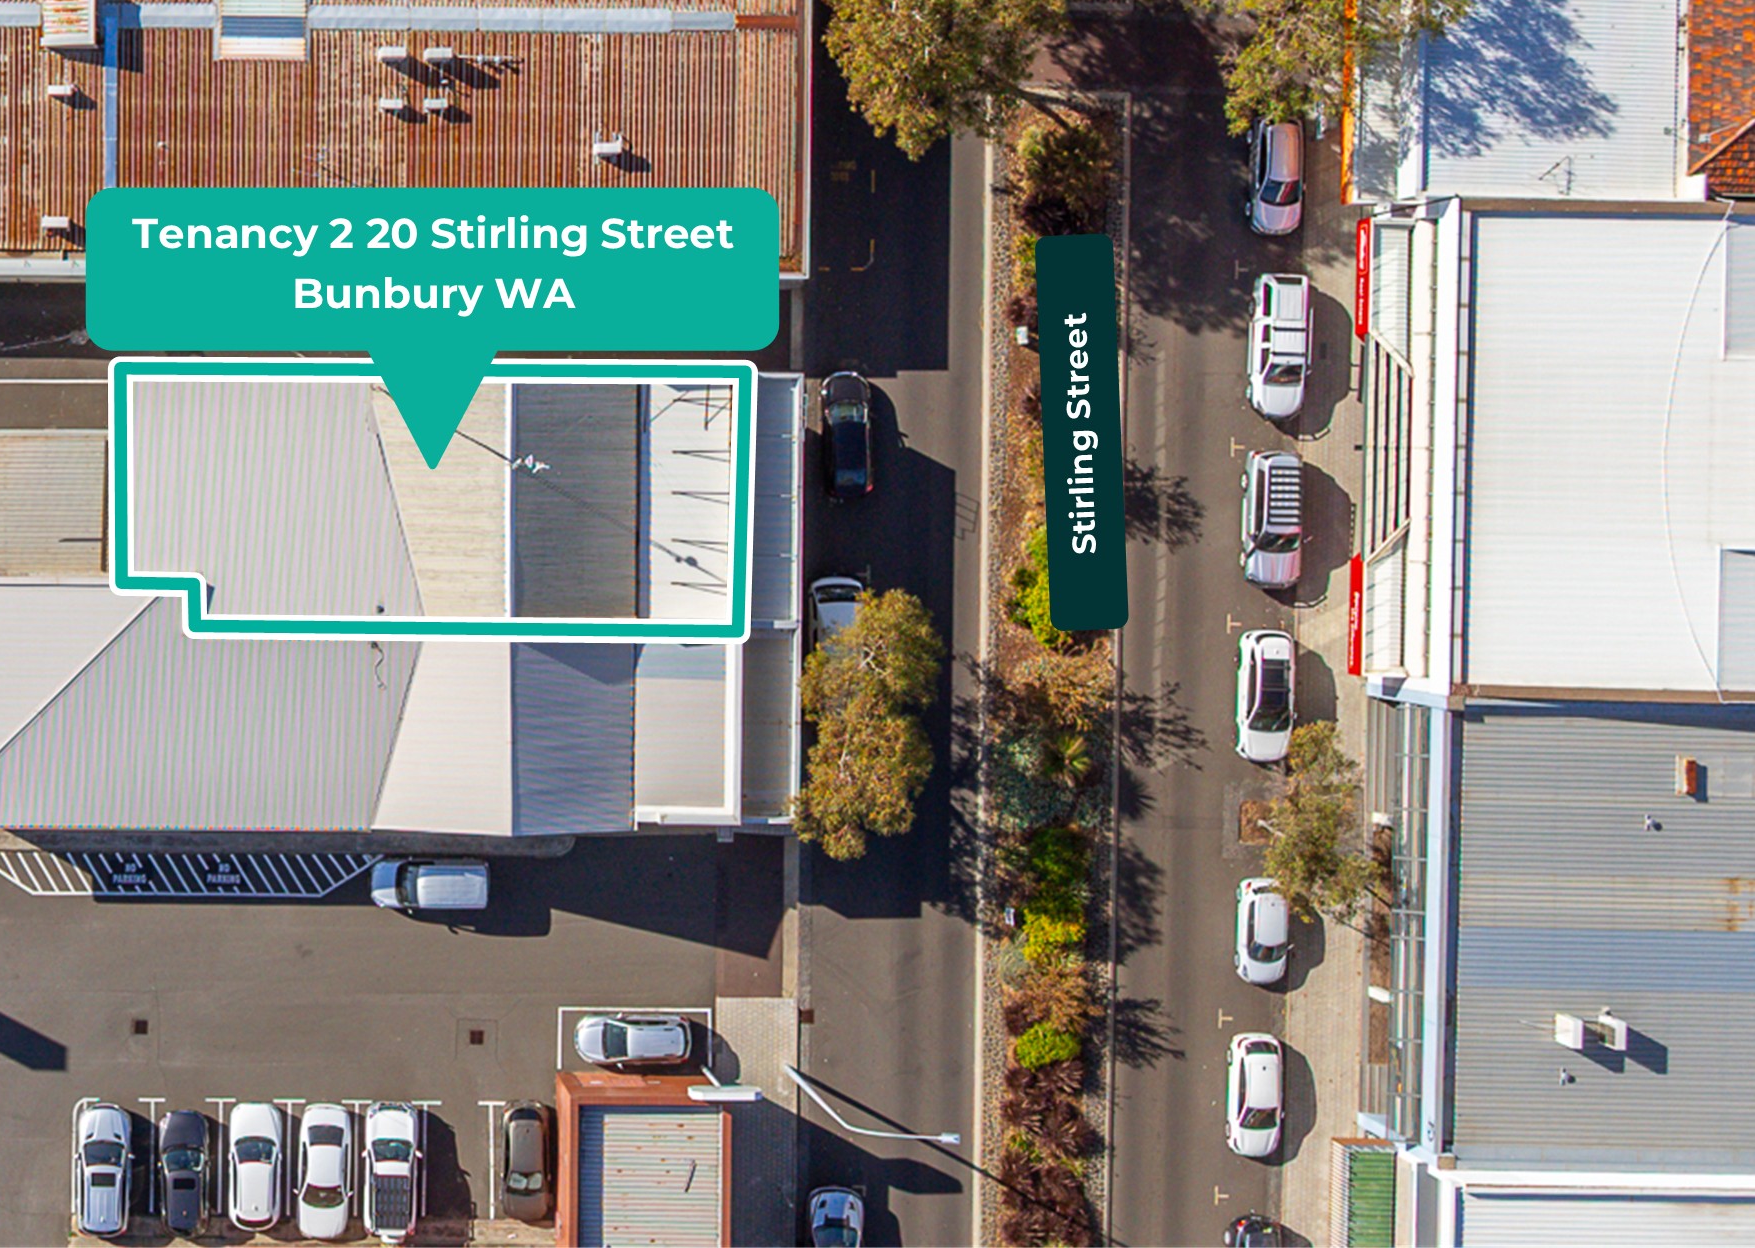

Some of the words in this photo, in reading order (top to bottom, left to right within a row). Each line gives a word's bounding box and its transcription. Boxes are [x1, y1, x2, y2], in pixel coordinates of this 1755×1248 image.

[125, 863, 136, 872] NO
[218, 863, 230, 872] NO
[113, 873, 147, 884] PARKING
[206, 873, 241, 884] PARKING
